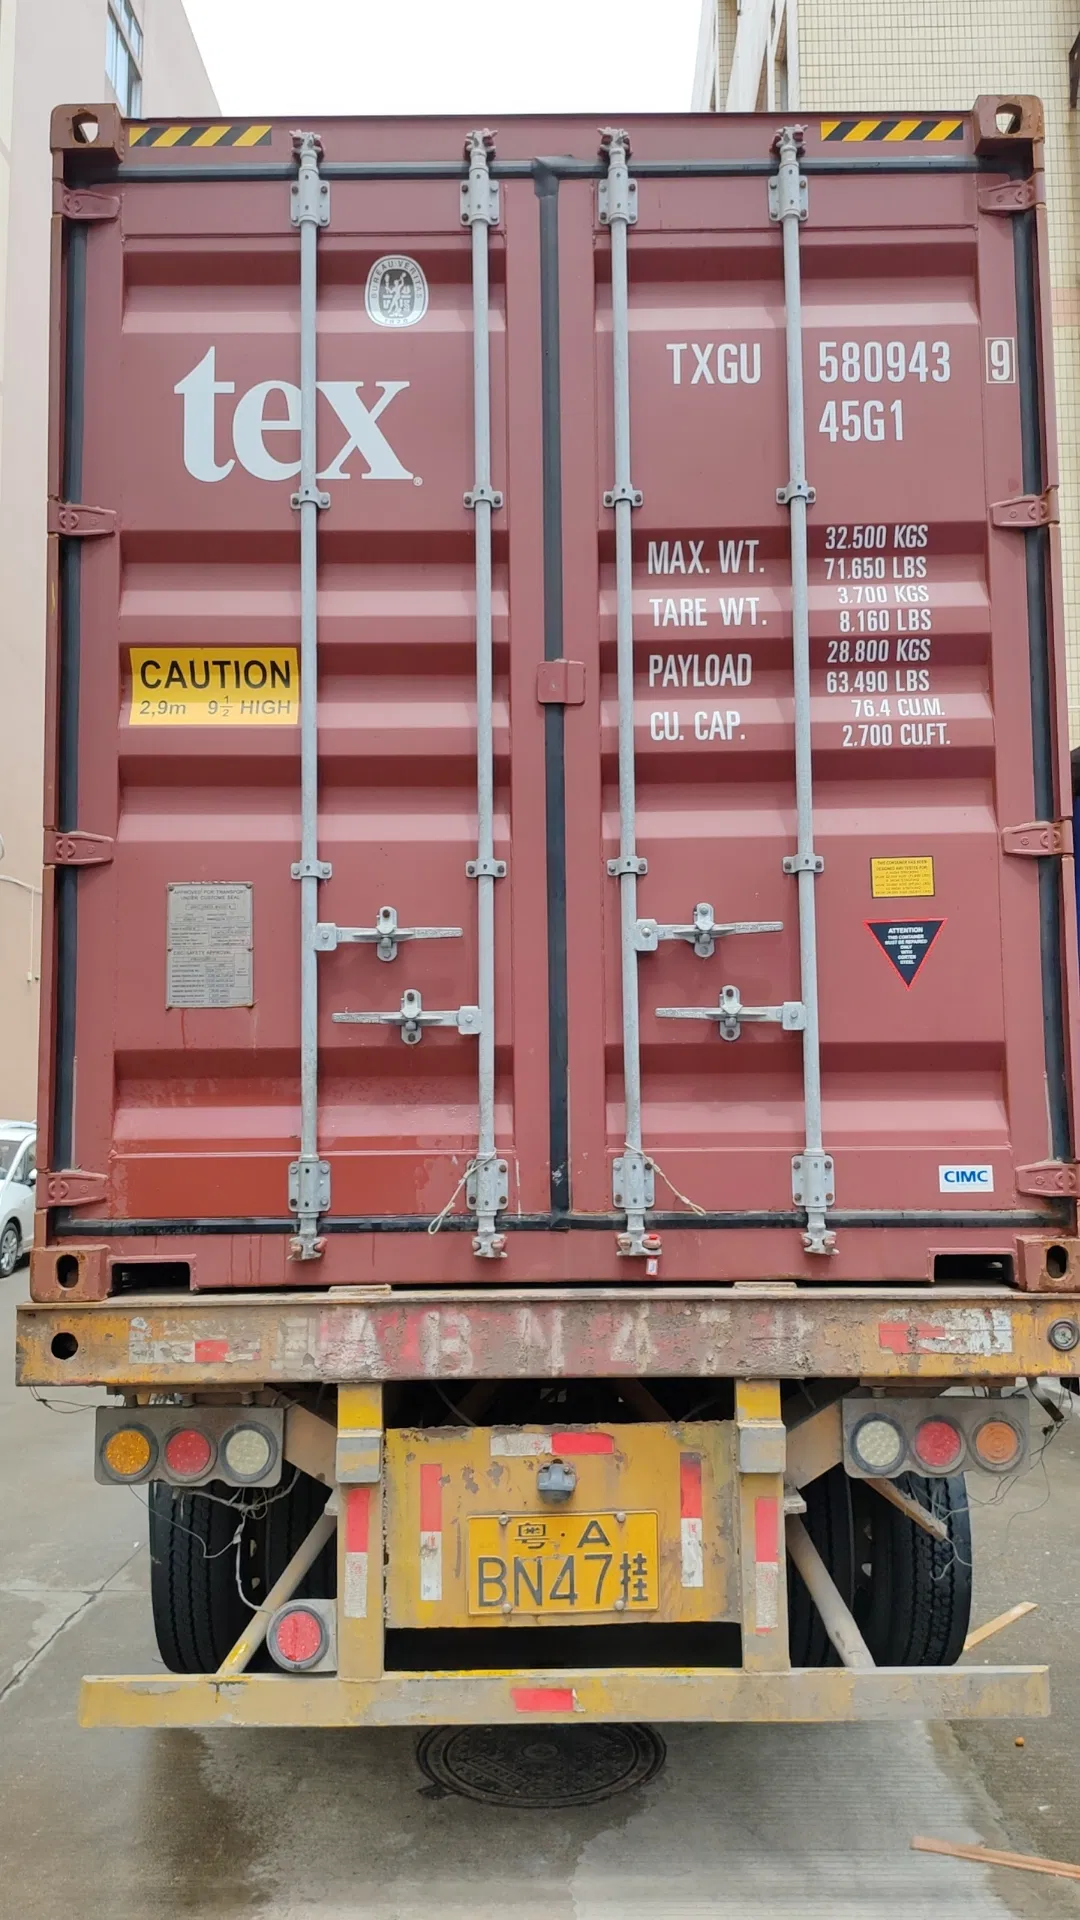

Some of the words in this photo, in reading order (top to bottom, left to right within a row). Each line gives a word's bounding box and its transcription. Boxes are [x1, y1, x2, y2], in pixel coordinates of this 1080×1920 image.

[371, 261, 393, 298] BUREAU
[398, 261, 422, 298] VERITAS
[666, 343, 761, 384] TXGU
[819, 341, 951, 383] 580943
[990, 340, 1011, 380] 9
[174, 346, 413, 482] tex
[819, 400, 904, 442] 45G1
[825, 525, 886, 550] 32.500
[894, 525, 928, 548] KGS
[647, 541, 711, 576] MAX.
[718, 540, 765, 573] WT.
[824, 558, 886, 580] 71.650
[893, 557, 926, 579] LBS
[838, 586, 887, 604] 3.700
[894, 586, 929, 603] KGS
[649, 598, 707, 627] TARE
[719, 597, 768, 626] WT.
[839, 610, 889, 632] 8.160
[897, 609, 932, 631] LBS
[827, 641, 889, 663] 28.800
[896, 639, 930, 661] KGS
[140, 660, 290, 689] CAUTION
[649, 654, 752, 687] PAYLOAD
[826, 671, 888, 693] 63.490
[895, 670, 930, 692] LBS
[140, 700, 186, 717] 2,9m
[240, 700, 290, 715] HIGH
[851, 699, 890, 717] 76.4
[650, 713, 685, 741] CU.
[694, 711, 746, 740] CAP.
[842, 724, 893, 747] 2.700
[888, 926, 924, 934] ATTENTION
[944, 1171, 988, 1183] CIMC
